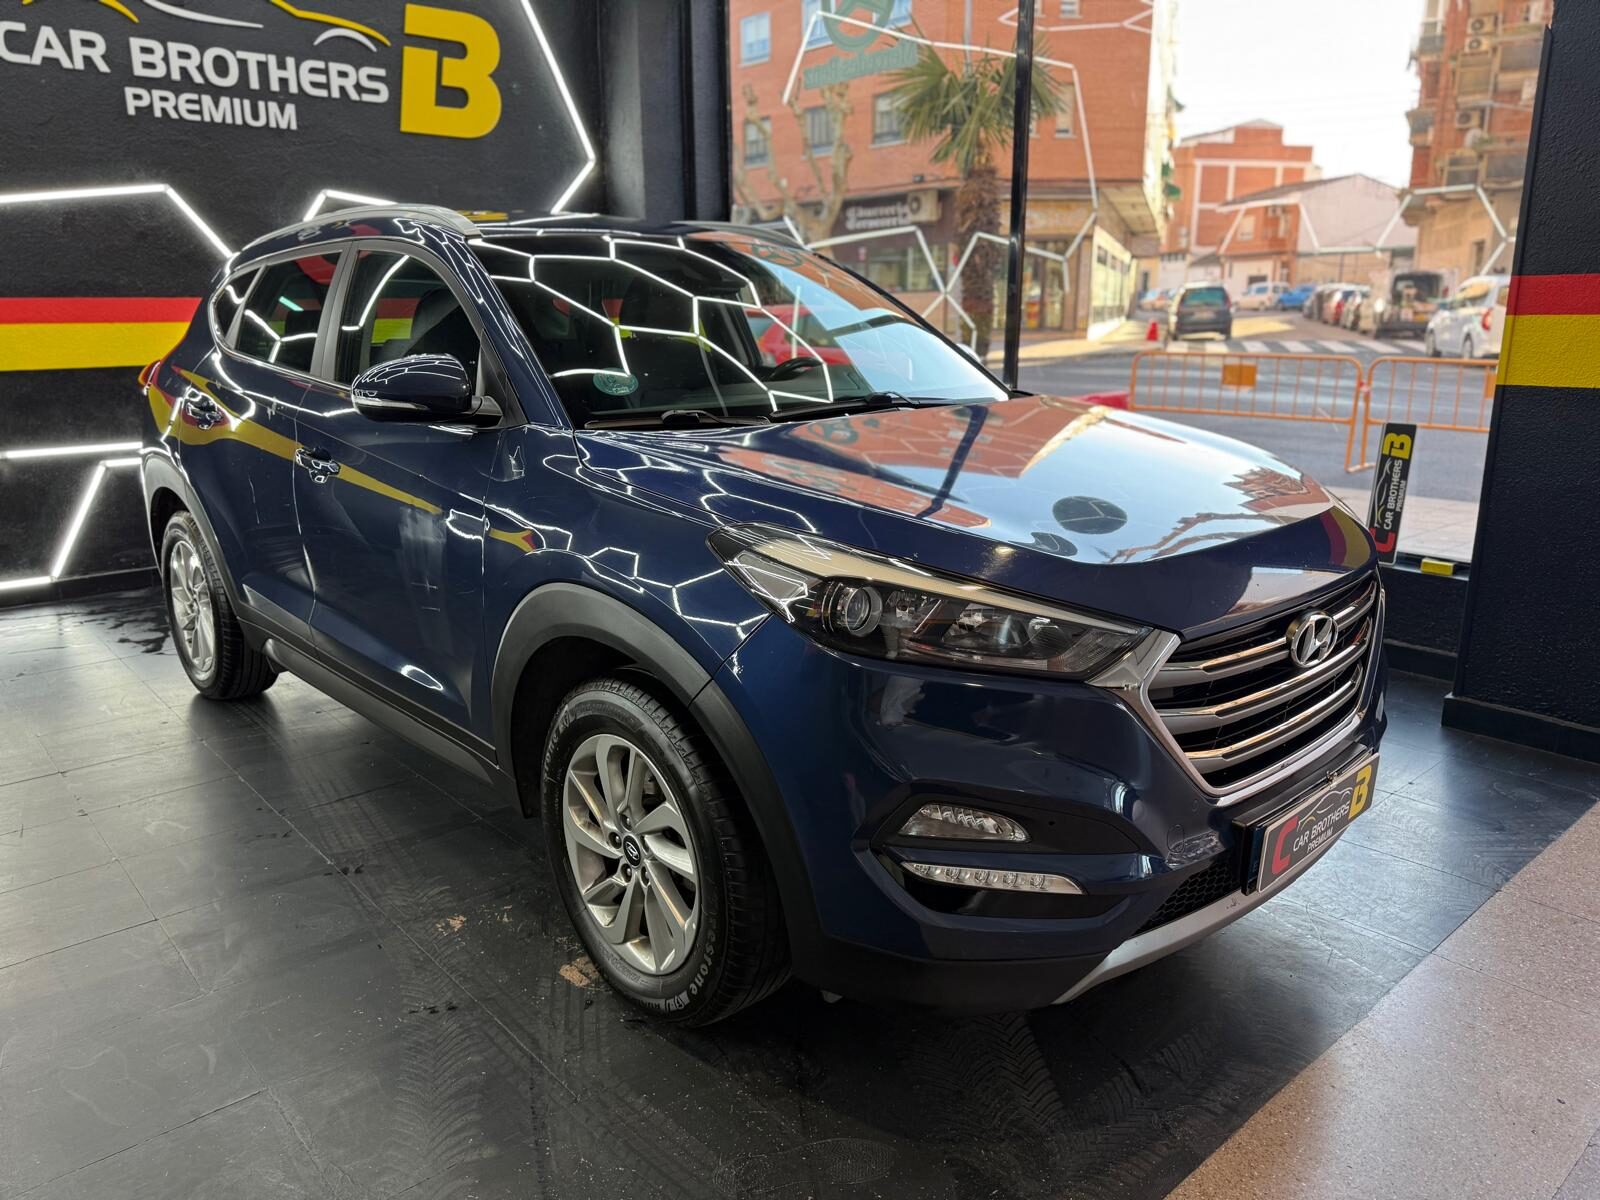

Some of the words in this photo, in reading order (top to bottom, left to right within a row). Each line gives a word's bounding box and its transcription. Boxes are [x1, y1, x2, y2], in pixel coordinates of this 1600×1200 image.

[0, 20, 111, 73] CAR
[129, 36, 390, 104] BROTHERS
[124, 86, 298, 131] PREMIUM
[1386, 459, 1403, 509] BROTHERS
[1395, 480, 1407, 512] PREMIUM
[1383, 511, 1394, 530] CAR
[1292, 831, 1310, 852] CAR
[1310, 800, 1351, 840] BROTHERS
[1306, 826, 1334, 853] PREMIUM
